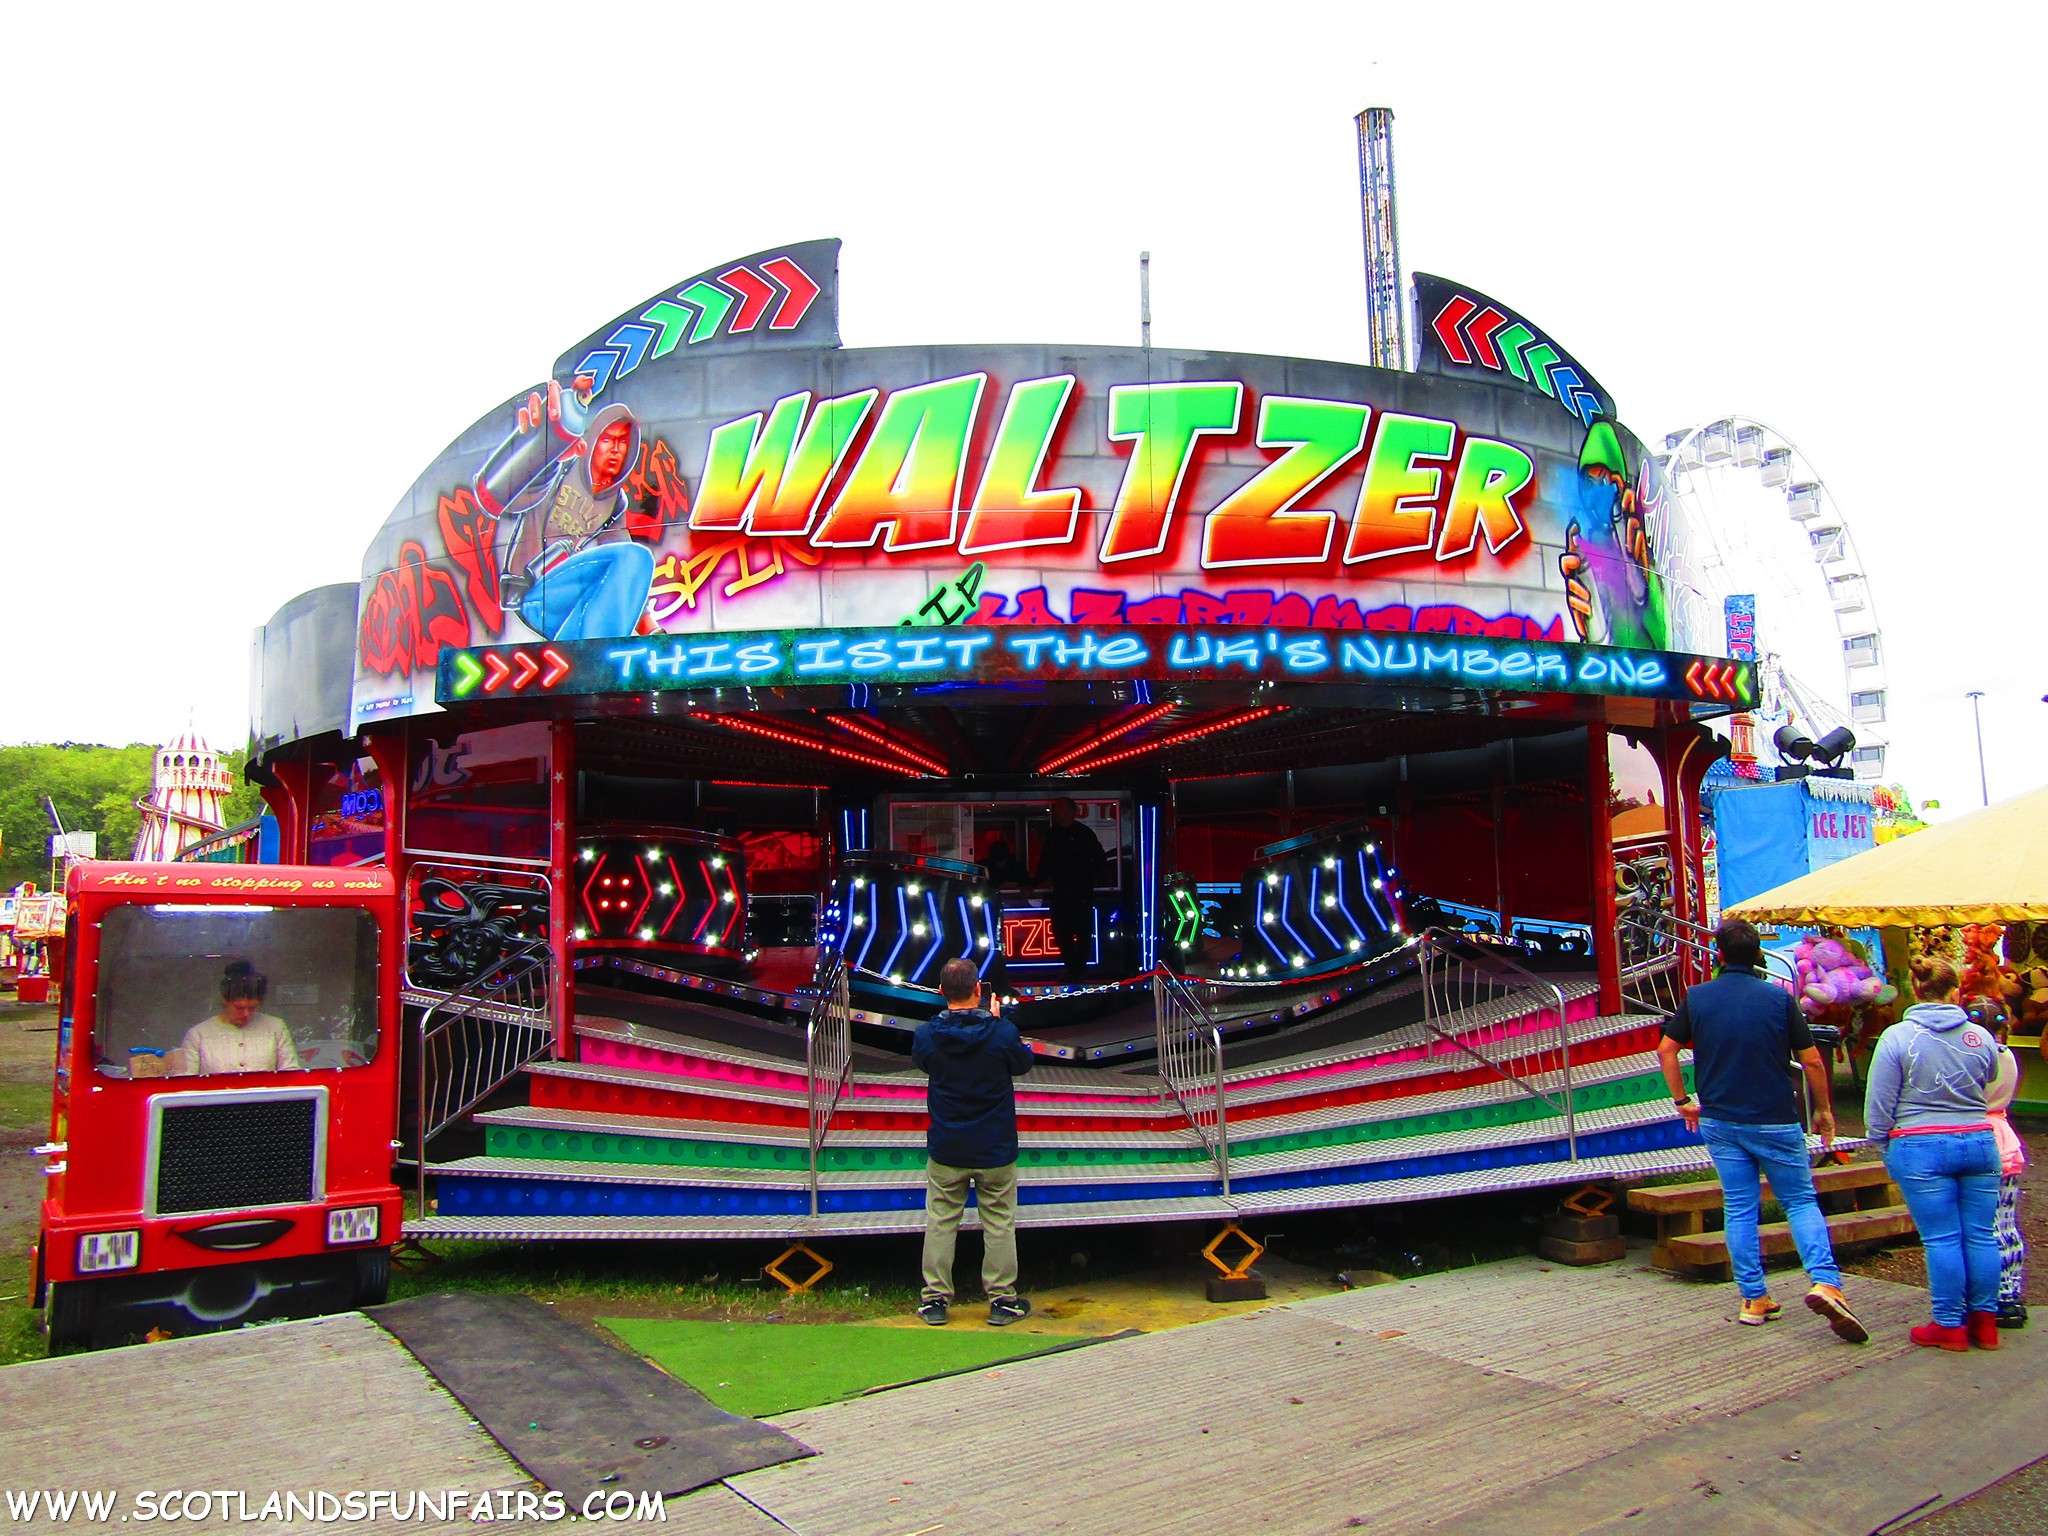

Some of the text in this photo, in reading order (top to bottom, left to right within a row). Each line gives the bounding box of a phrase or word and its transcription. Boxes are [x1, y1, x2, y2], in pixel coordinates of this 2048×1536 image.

[690, 372, 1534, 568] WALTZER
[901, 562, 984, 626] IP
[1728, 612, 1753, 654] JET
[609, 642, 780, 677] THIS
[1170, 634, 1325, 668] UK'S
[1812, 813, 1867, 839] ICE JET
[98, 871, 384, 892] Ain't no stopping us now
